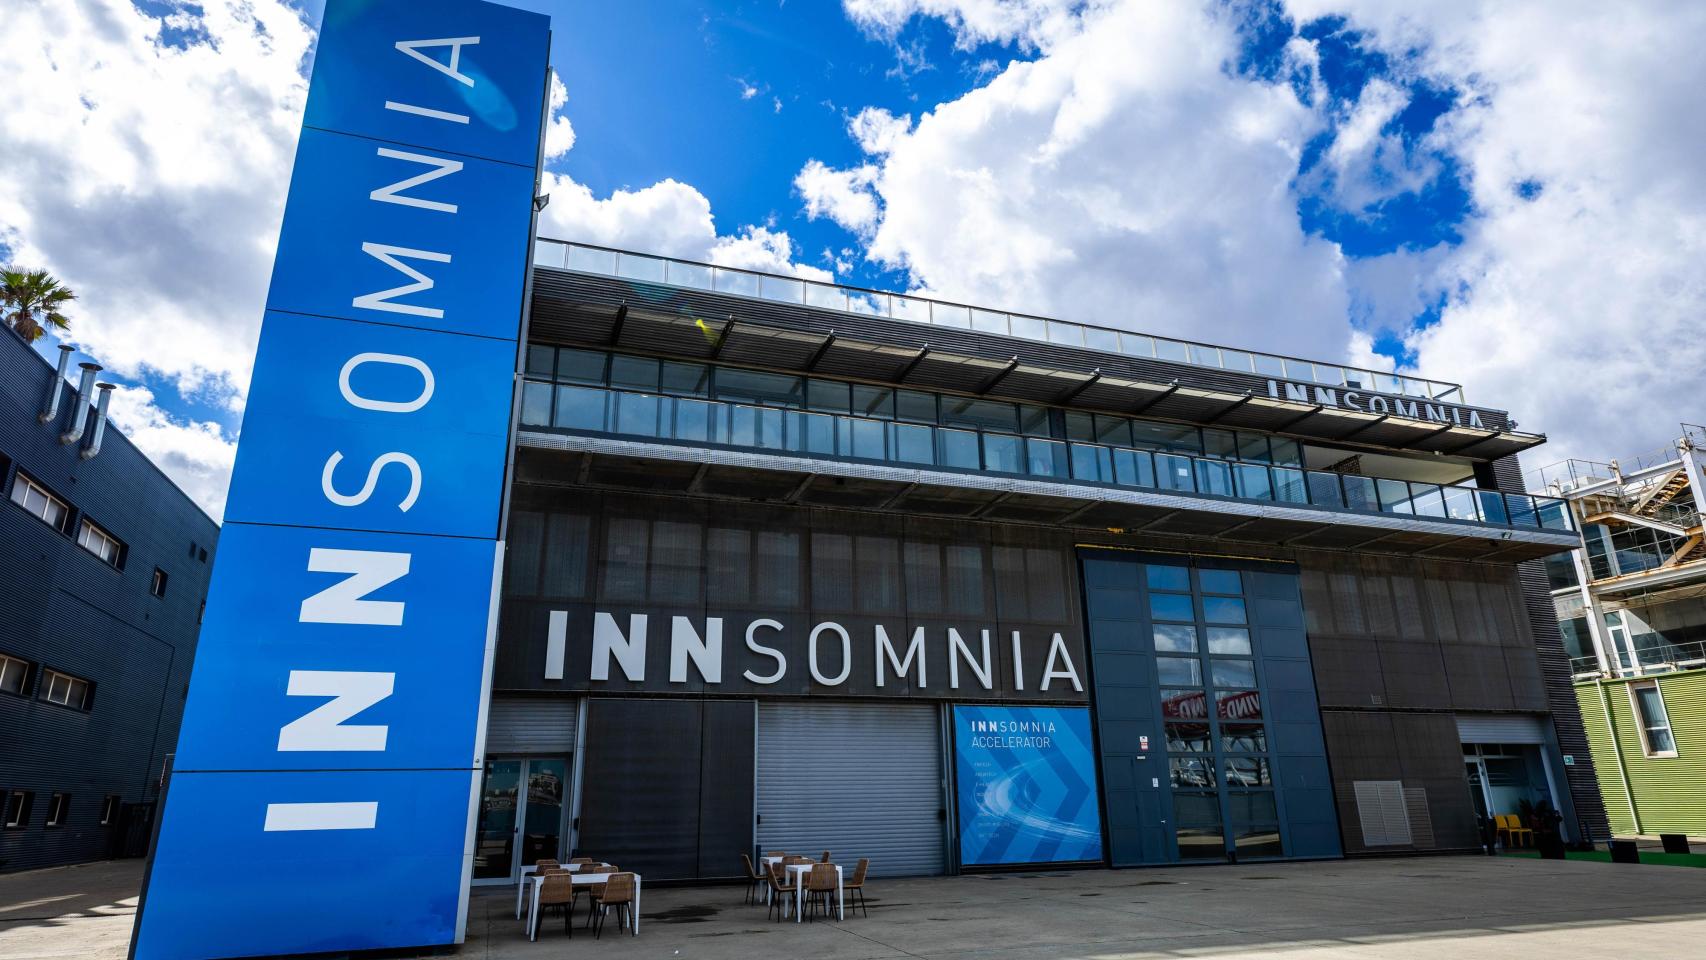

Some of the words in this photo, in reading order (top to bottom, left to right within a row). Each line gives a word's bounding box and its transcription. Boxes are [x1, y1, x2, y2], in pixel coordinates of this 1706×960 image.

[1267, 380, 1485, 430] INNSOMNIA
[264, 36, 481, 832] INNSOMNIA
[544, 610, 1084, 691] INNSOMNIA
[971, 721, 1056, 733] INNSOMNIA
[972, 736, 1051, 748] ACCELERATOR
